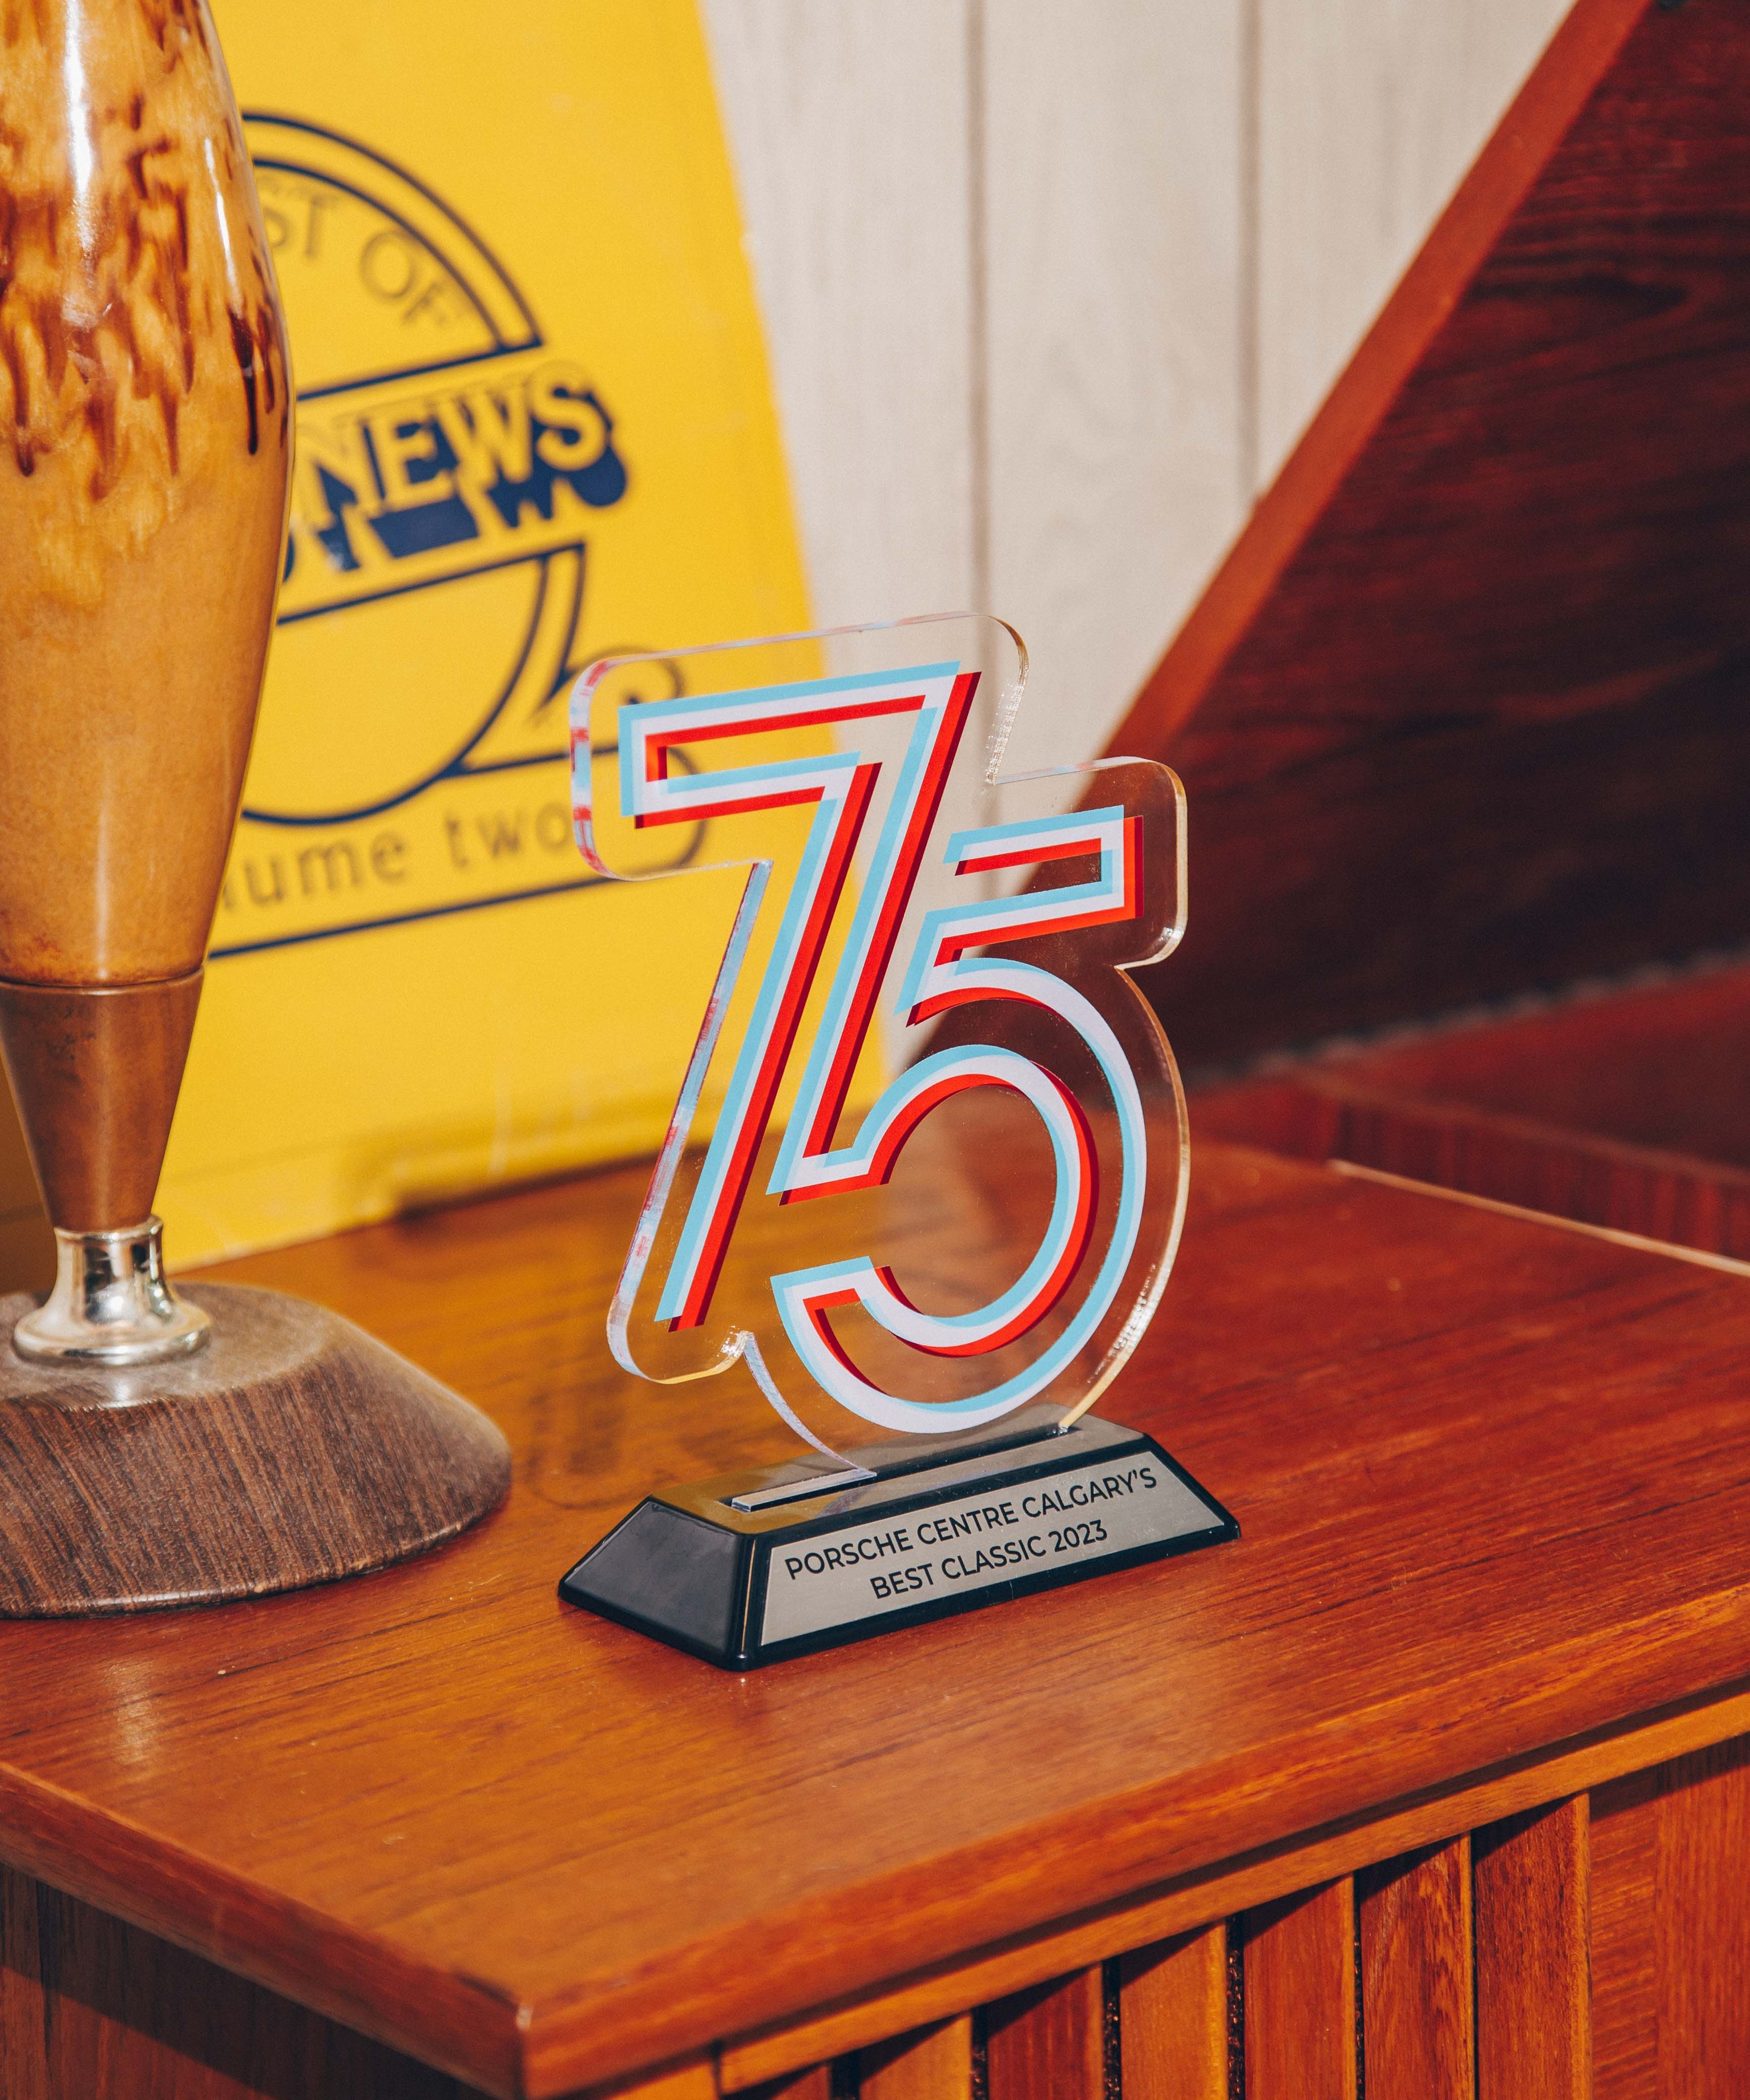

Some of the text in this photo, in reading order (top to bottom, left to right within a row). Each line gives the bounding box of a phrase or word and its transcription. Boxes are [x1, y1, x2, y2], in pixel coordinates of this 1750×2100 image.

[358, 226, 469, 328] OF
[444, 802, 572, 872] two
[619, 661, 1146, 1433] 75
[785, 1468, 1157, 1580] PORSCHE CENTRE CALGARY'S
[870, 1519, 1107, 1599] BEST CLASSIC 2023
